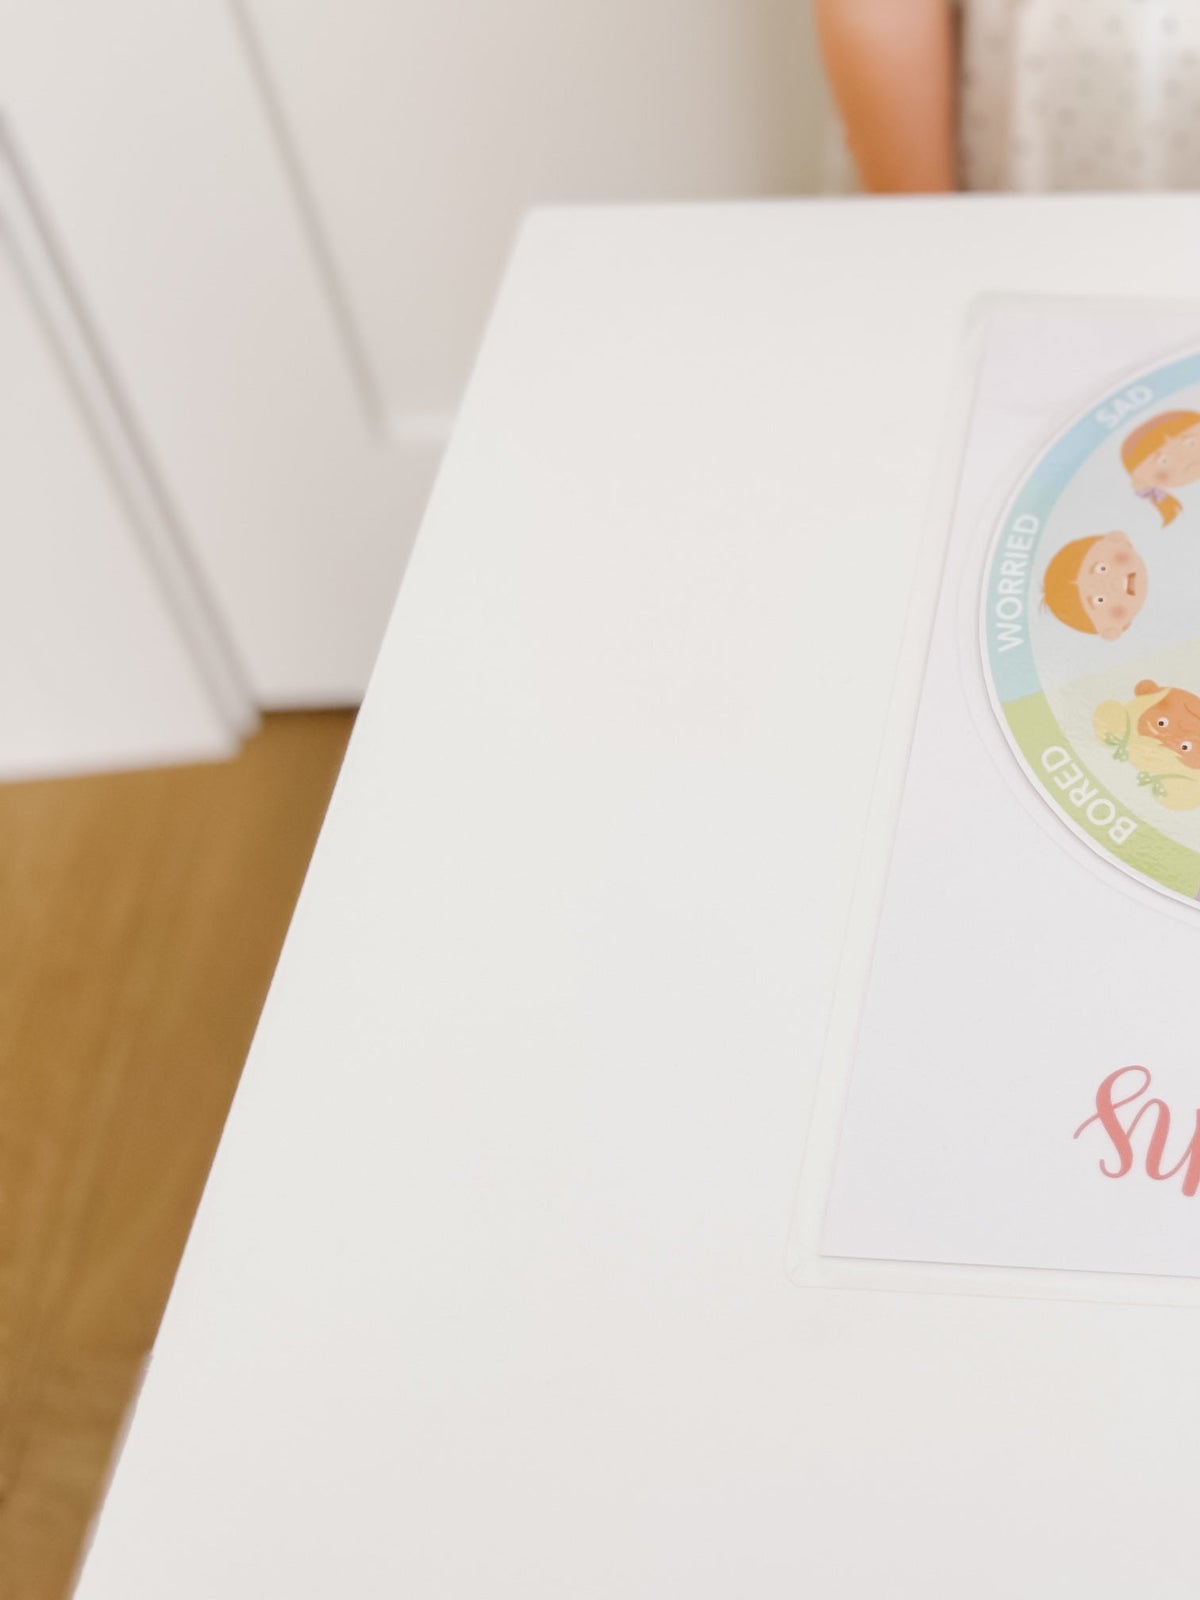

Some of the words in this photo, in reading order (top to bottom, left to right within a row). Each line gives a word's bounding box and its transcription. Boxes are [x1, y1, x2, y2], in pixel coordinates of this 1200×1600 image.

[1097, 384, 1155, 429] SAD
[996, 512, 1039, 653] WORRIED
[1041, 745, 1136, 844] BORED
